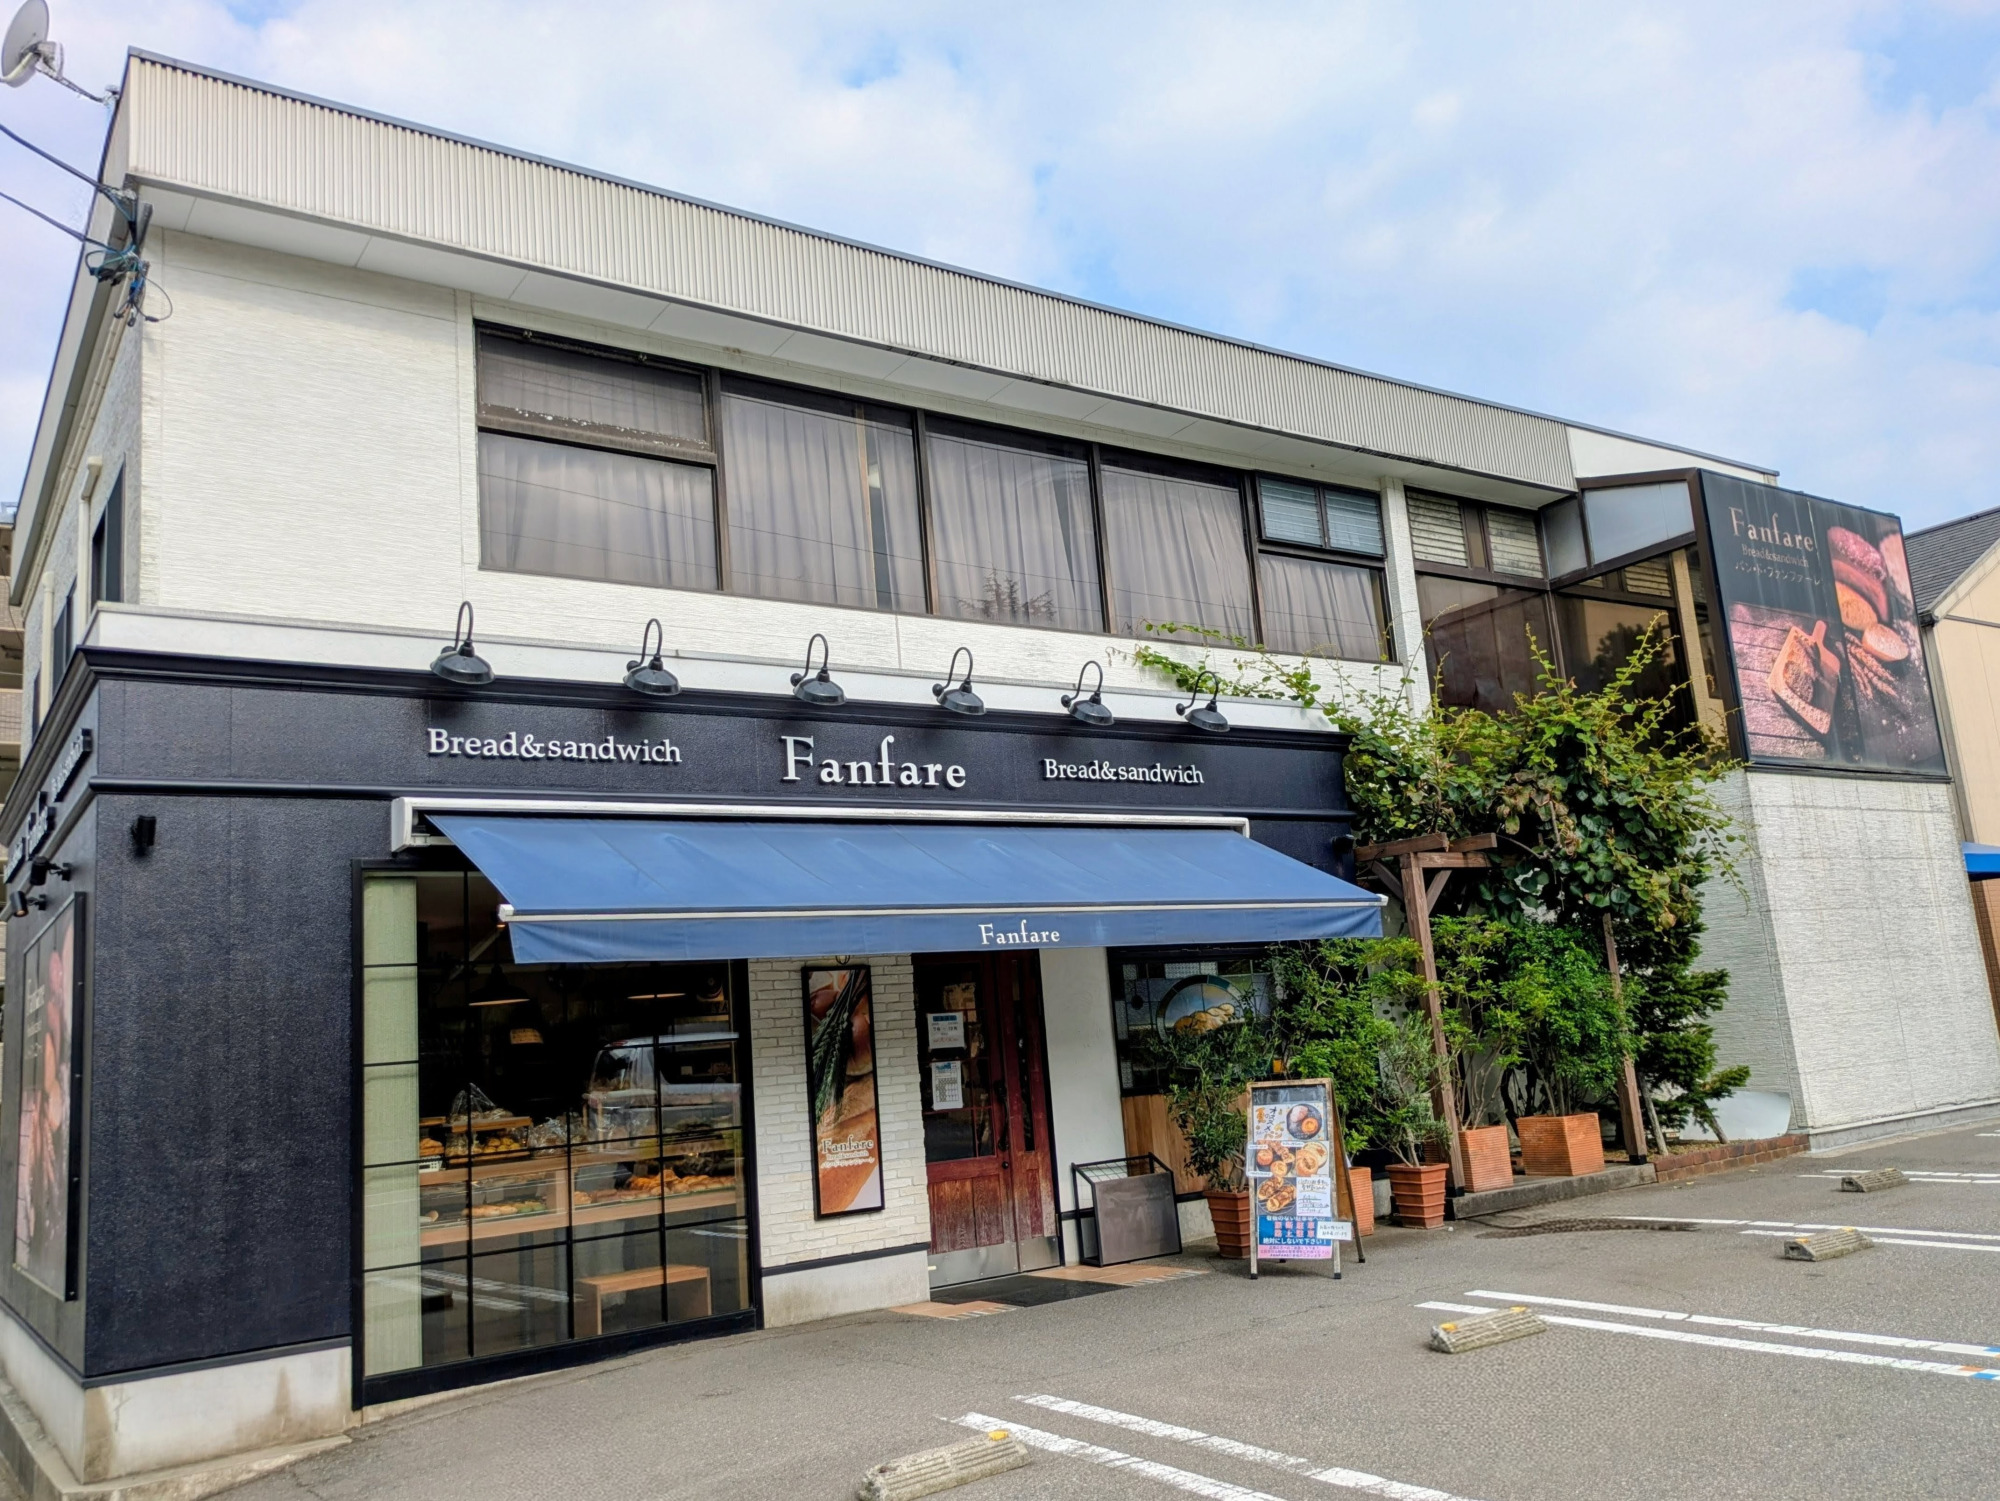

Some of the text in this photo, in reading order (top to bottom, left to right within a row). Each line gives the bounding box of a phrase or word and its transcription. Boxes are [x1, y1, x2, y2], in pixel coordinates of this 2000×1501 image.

[1728, 506, 1814, 552] Fanfare
[1741, 544, 1809, 568] Bread&sandwich
[427, 727, 683, 766] Bread&sandwich
[781, 735, 968, 790] Fanfare
[1043, 757, 1205, 787] Bread&sandwich
[979, 919, 1061, 948] Fanfare
[822, 1135, 874, 1153] Fanfare
